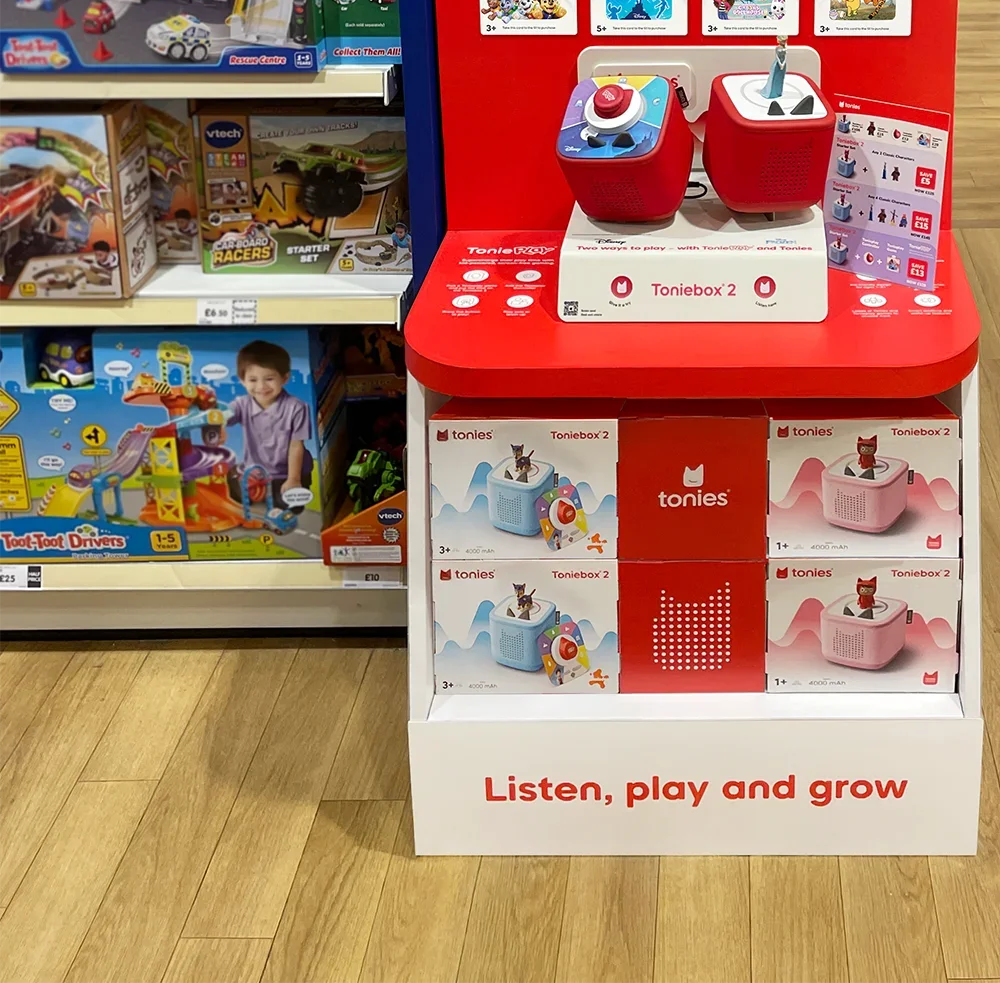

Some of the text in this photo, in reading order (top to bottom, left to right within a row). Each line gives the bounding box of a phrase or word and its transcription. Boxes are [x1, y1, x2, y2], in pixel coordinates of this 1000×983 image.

[486, 24, 496, 32] 3+
[597, 24, 606, 32] 5+
[820, 25, 830, 33] 3+
[333, 48, 402, 56] Collect Them All!
[229, 56, 286, 65] Rescue Centre
[206, 128, 243, 139] vtech
[256, 121, 359, 140] CREATE YOUR OWN TRACKS!
[919, 171, 933, 179] SAVE
[914, 222, 928, 230] £15
[216, 238, 269, 250] CAR-BOARD
[286, 244, 330, 254] STARTER
[213, 247, 271, 263] RACERS
[300, 254, 319, 263] SET
[910, 269, 924, 277] £13
[651, 284, 736, 297] Toniebox 2
[452, 429, 492, 440] tonies
[551, 430, 609, 439] Toniebox 2
[793, 426, 833, 436] tonies
[891, 427, 950, 436] Toniebox 2
[658, 489, 729, 507] tonies
[378, 512, 403, 520] vtech
[1, 533, 125, 550] Toot-Toot Drivers
[156, 533, 175, 543] 1-5
[439, 546, 451, 554] 3+
[776, 542, 789, 550] 1+
[365, 573, 380, 581] £10
[455, 569, 494, 580] tonies
[552, 570, 609, 579] Toniebox 2
[792, 567, 832, 578] tonies
[891, 569, 950, 578] Toniebox 2
[442, 681, 454, 690] 3+
[774, 678, 787, 686] 1+
[484, 774, 909, 808] Listen, play and grow
